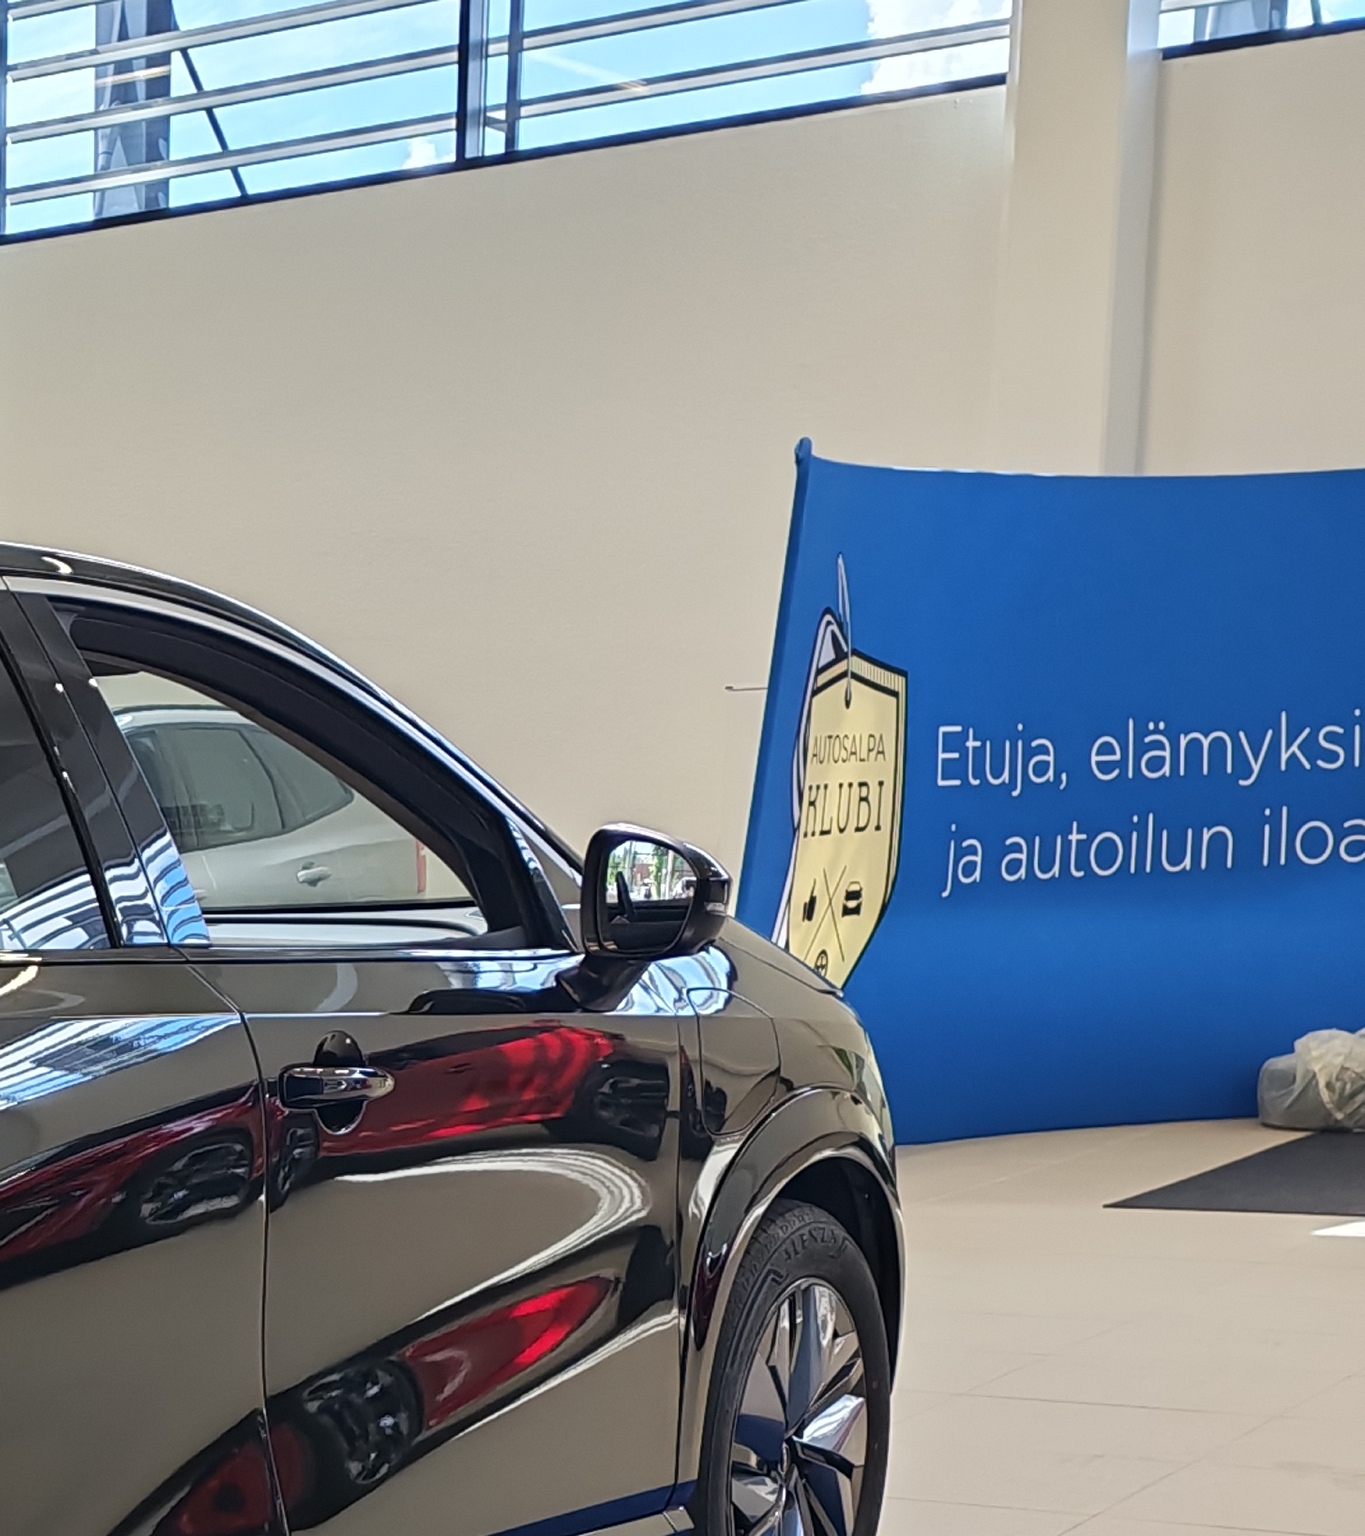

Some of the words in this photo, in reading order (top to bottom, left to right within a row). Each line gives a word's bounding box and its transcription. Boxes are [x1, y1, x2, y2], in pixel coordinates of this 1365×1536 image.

[811, 733, 886, 765] AUTOSALPA
[935, 722, 1069, 797] Etuja,
[1089, 707, 1362, 787] elämyksi
[803, 780, 885, 839] KLUBI
[941, 823, 983, 898] ja
[999, 812, 1235, 882] autoilun
[1262, 804, 1365, 868] iloa
